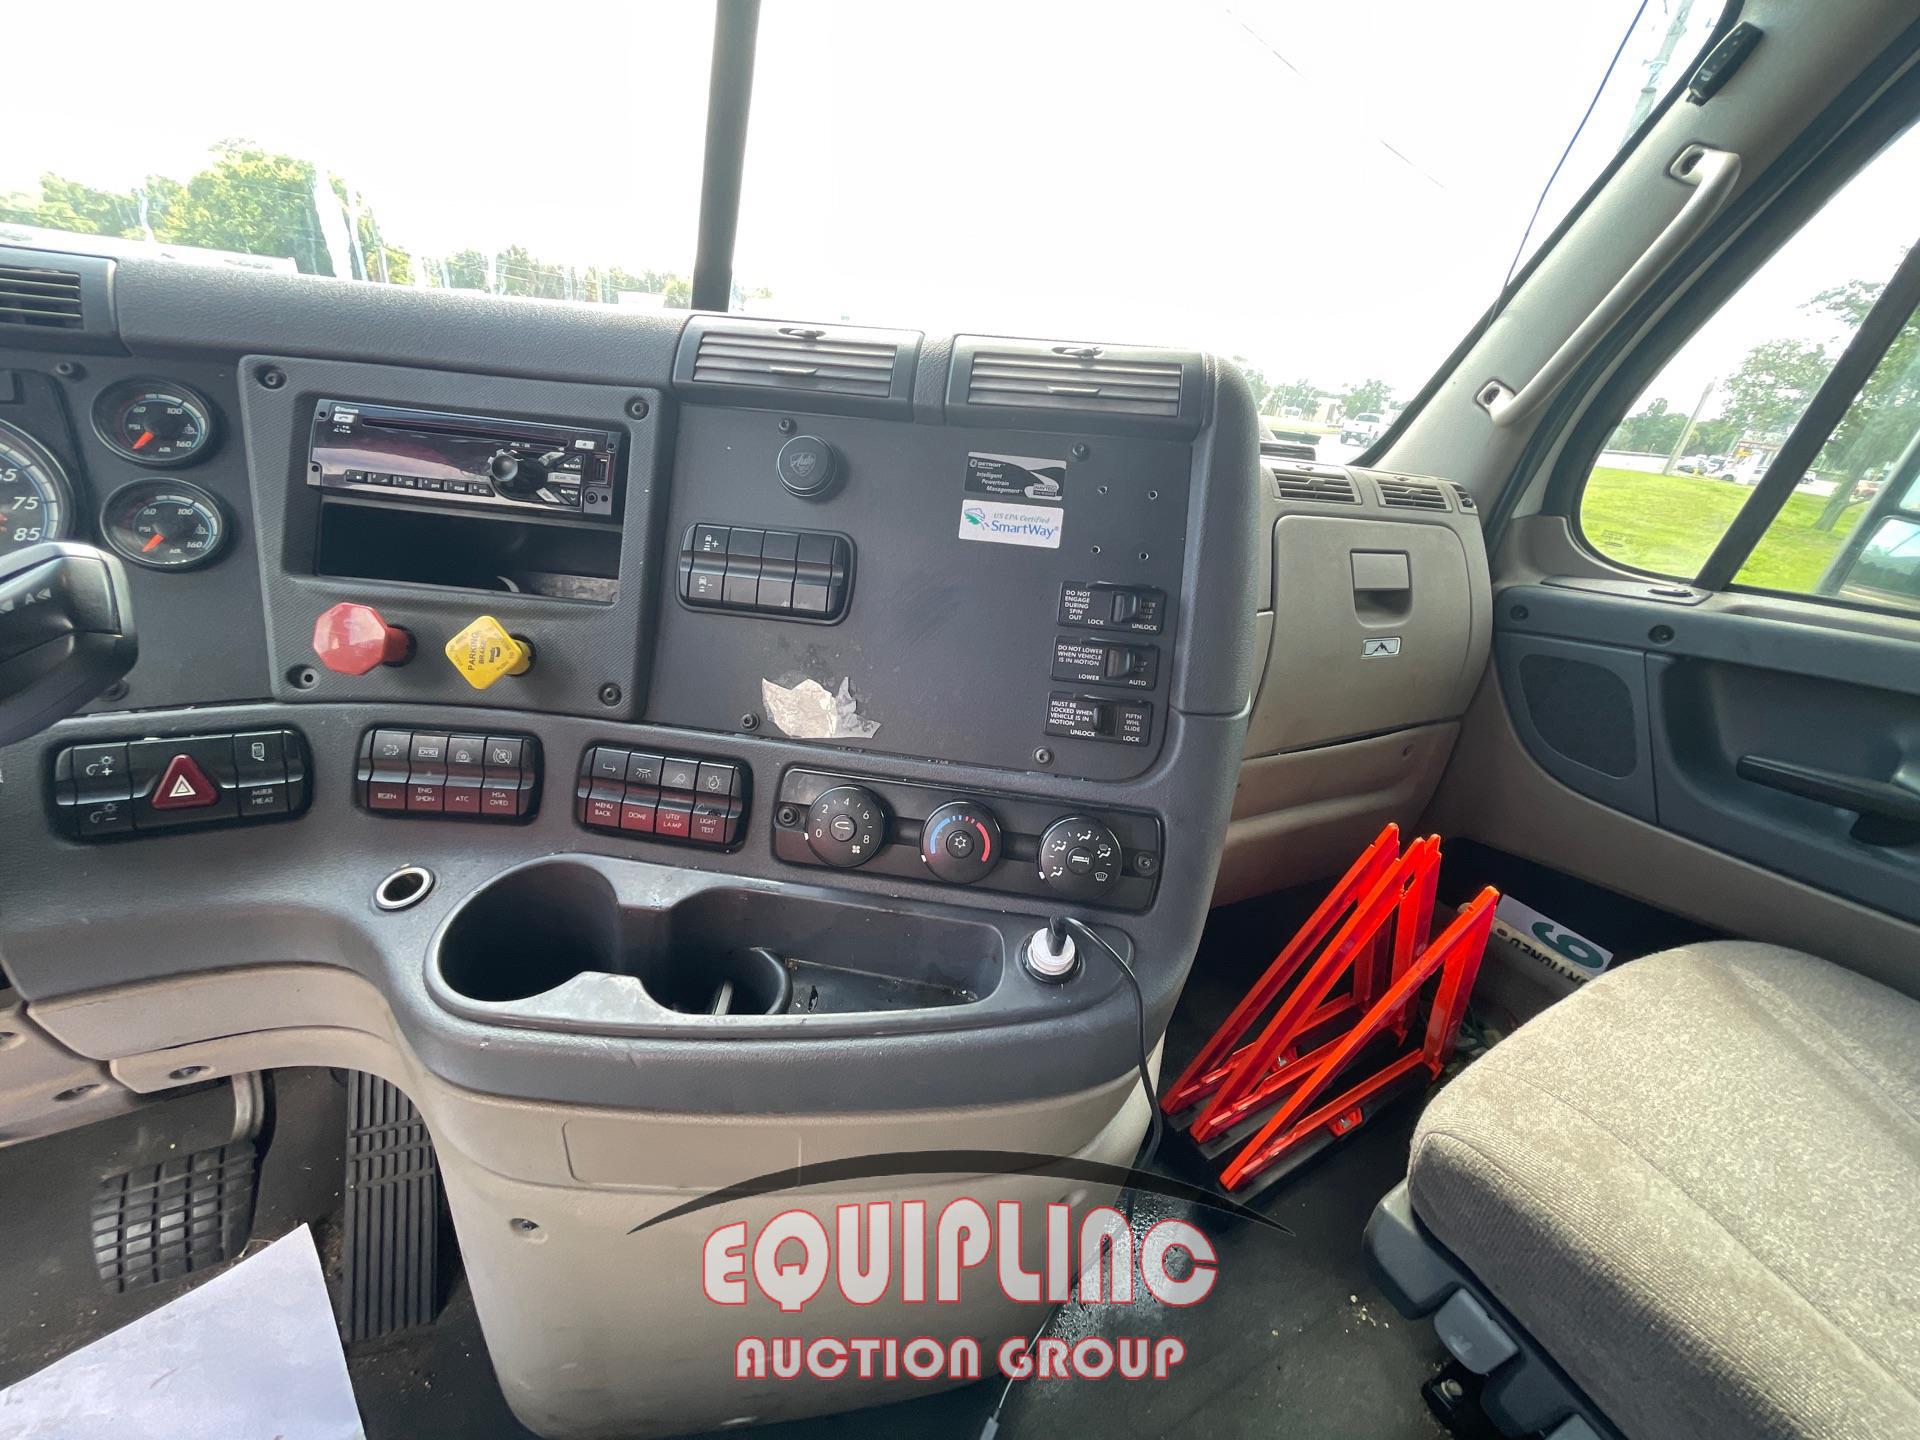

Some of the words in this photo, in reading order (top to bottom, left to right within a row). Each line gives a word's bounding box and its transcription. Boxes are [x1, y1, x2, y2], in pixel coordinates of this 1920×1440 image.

[167, 407, 183, 415] 100
[976, 472, 1002, 480] Intelligent
[986, 486, 1020, 494] Management
[12, 496, 40, 510] 75
[1020, 514, 1050, 523] Certified
[14, 527, 41, 541] 85
[992, 520, 1054, 539] SmartWay
[468, 632, 479, 671] PARKING
[844, 797, 850, 806] 4
[822, 804, 828, 814] 2
[863, 810, 869, 820] 6
[816, 829, 822, 838] 0
[864, 835, 870, 844] 8
